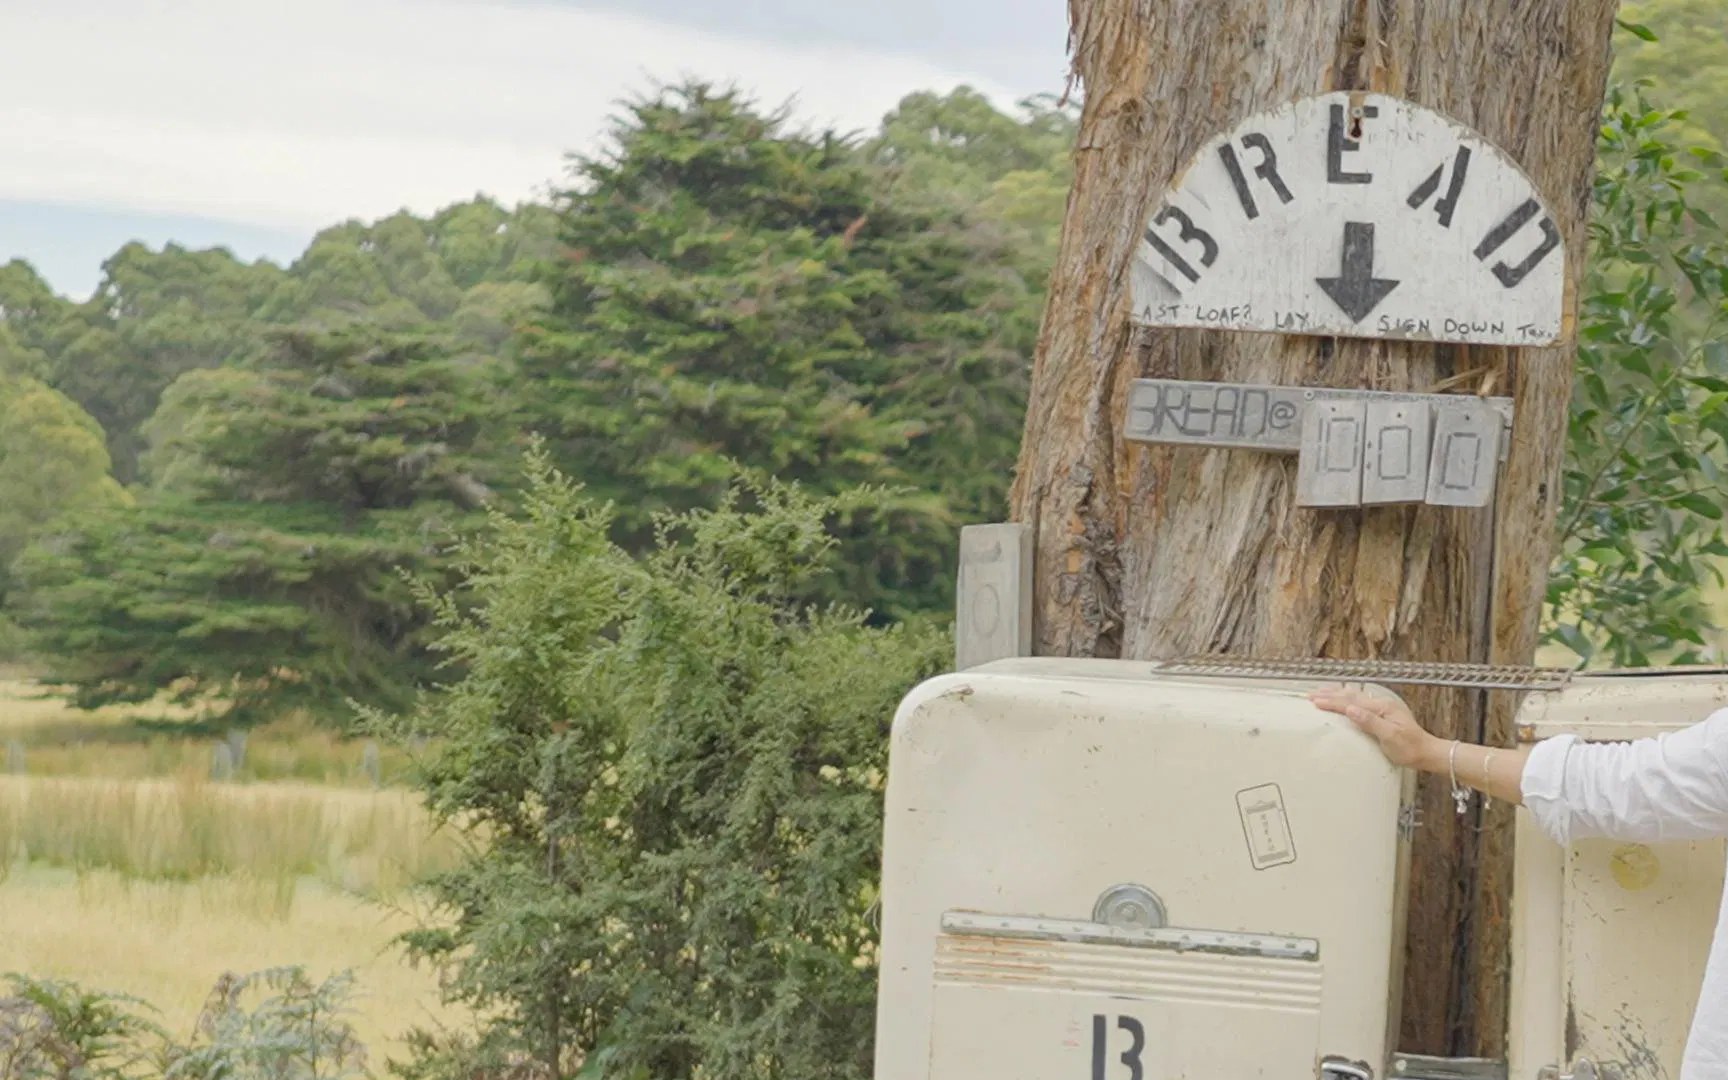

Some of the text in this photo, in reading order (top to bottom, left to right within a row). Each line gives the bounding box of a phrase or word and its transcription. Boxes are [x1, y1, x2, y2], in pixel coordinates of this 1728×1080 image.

[1144, 104, 1561, 288] BREAD
[1377, 315, 1430, 332] SIGN
[1444, 319, 1505, 335] DOWN
